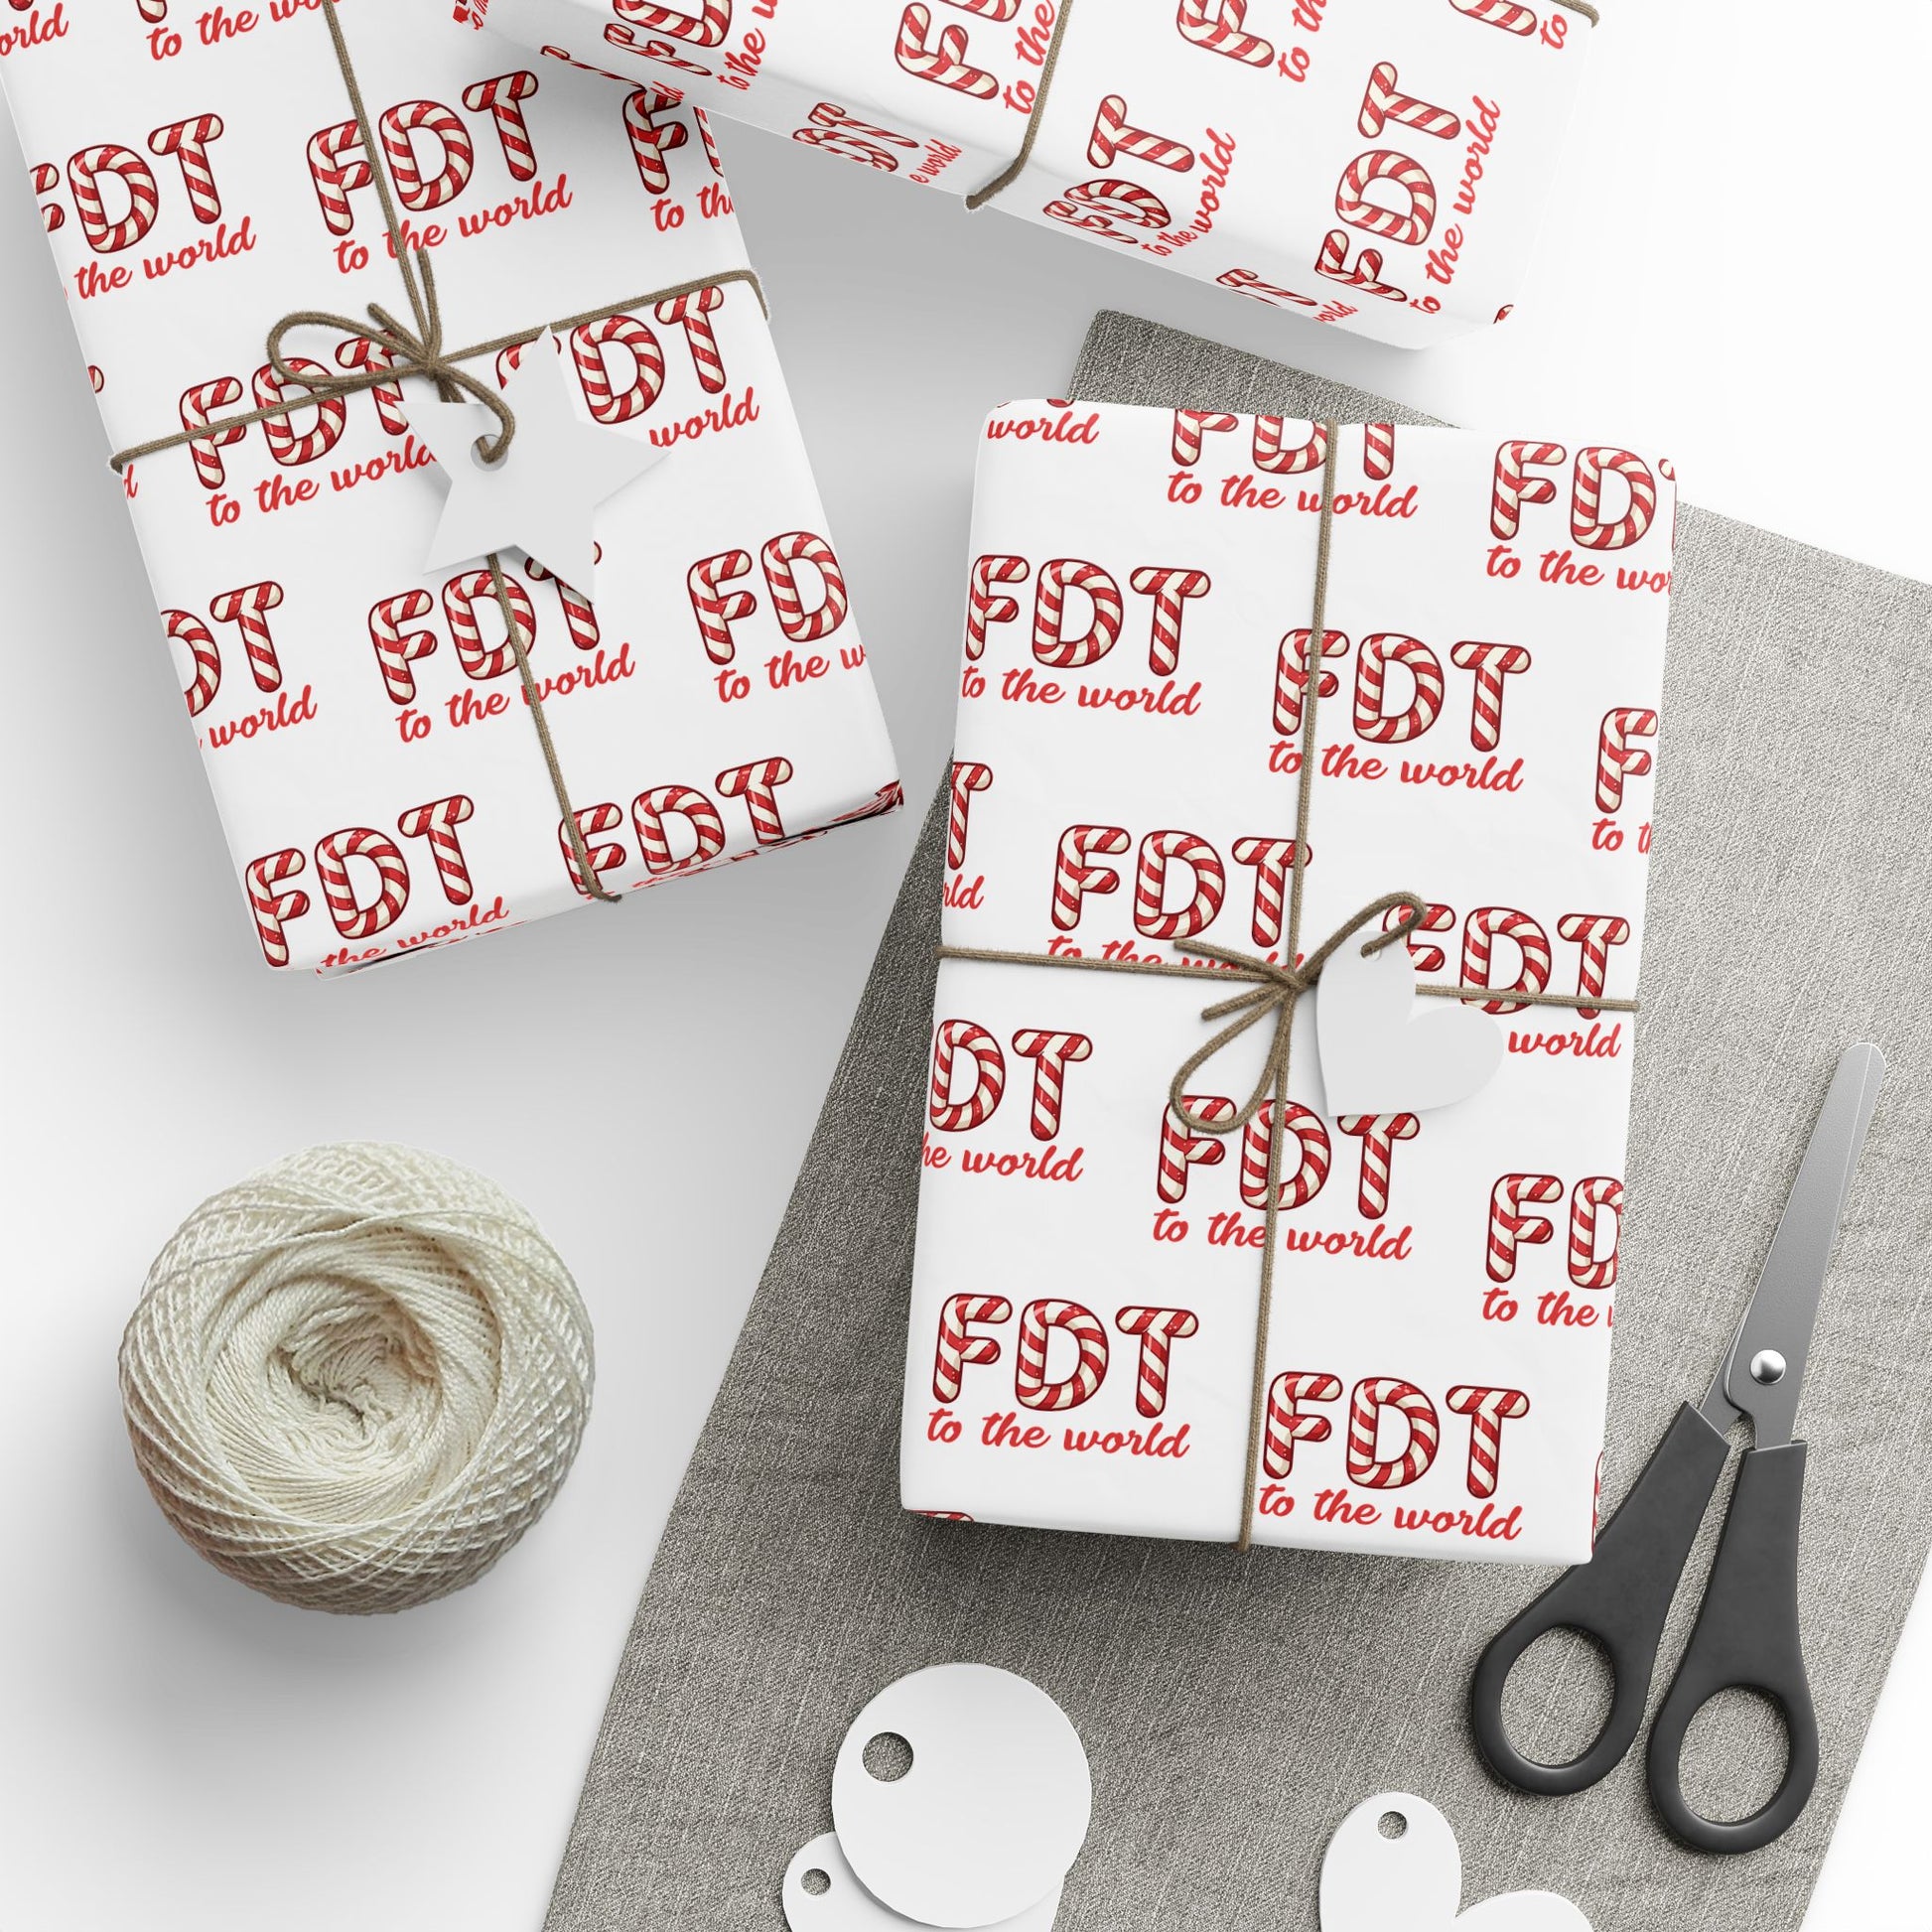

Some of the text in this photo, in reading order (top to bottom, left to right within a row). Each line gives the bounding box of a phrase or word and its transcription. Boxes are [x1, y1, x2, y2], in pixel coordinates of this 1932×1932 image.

[0, 2, 69, 57] orld
[146, 27, 183, 61] to
[196, 6, 259, 46] the
[723, 28, 766, 76] the
[1003, 0, 1055, 114] to the
[1277, 0, 1326, 82] to th
[1540, 14, 1568, 50] to
[716, 73, 751, 91] to
[306, 70, 538, 236] FDT
[792, 101, 919, 173] DT
[1042, 94, 1195, 244] FDT
[650, 182, 735, 233] to th
[1141, 127, 1236, 257] to the world
[1314, 62, 1461, 302] FDT
[1409, 95, 1501, 315] to the world
[73, 215, 257, 300] the world
[334, 173, 573, 274] to the world
[179, 330, 410, 490] FDT
[649, 386, 759, 448] world
[987, 410, 1100, 445] world
[207, 493, 241, 527] to
[254, 474, 320, 513] the
[1168, 471, 1419, 518] to the world
[1490, 440, 1676, 551] FD
[686, 531, 848, 665] FD
[1486, 544, 1521, 579] to
[1539, 549, 1604, 586] the
[368, 541, 603, 706] FDT
[966, 554, 1210, 676] FDT
[395, 642, 636, 744] to the world
[714, 669, 751, 703] to
[764, 649, 830, 689] the
[961, 665, 1202, 716] to the world
[1273, 627, 1532, 753] FDT
[208, 684, 318, 749] world
[1269, 740, 1525, 792] to the world
[558, 757, 793, 896] FDT
[1591, 818, 1624, 852] to
[246, 794, 475, 968] FDT
[943, 874, 985, 909] rld
[1051, 824, 1312, 948] FDT
[397, 896, 509, 948] world
[1508, 1023, 1622, 1057] world
[929, 1019, 1093, 1142] DT
[921, 1132, 1084, 1181] he world
[1158, 1095, 1421, 1221] FDT
[1153, 1208, 1413, 1261] to the world
[1486, 1173, 1624, 1290] FD
[1482, 1287, 1518, 1321] to
[1537, 1291, 1599, 1327] the
[932, 1293, 1199, 1419] FDT
[927, 1408, 1190, 1458] to the world
[1263, 1371, 1531, 1499] FDT
[1259, 1483, 1523, 1541] to the world
